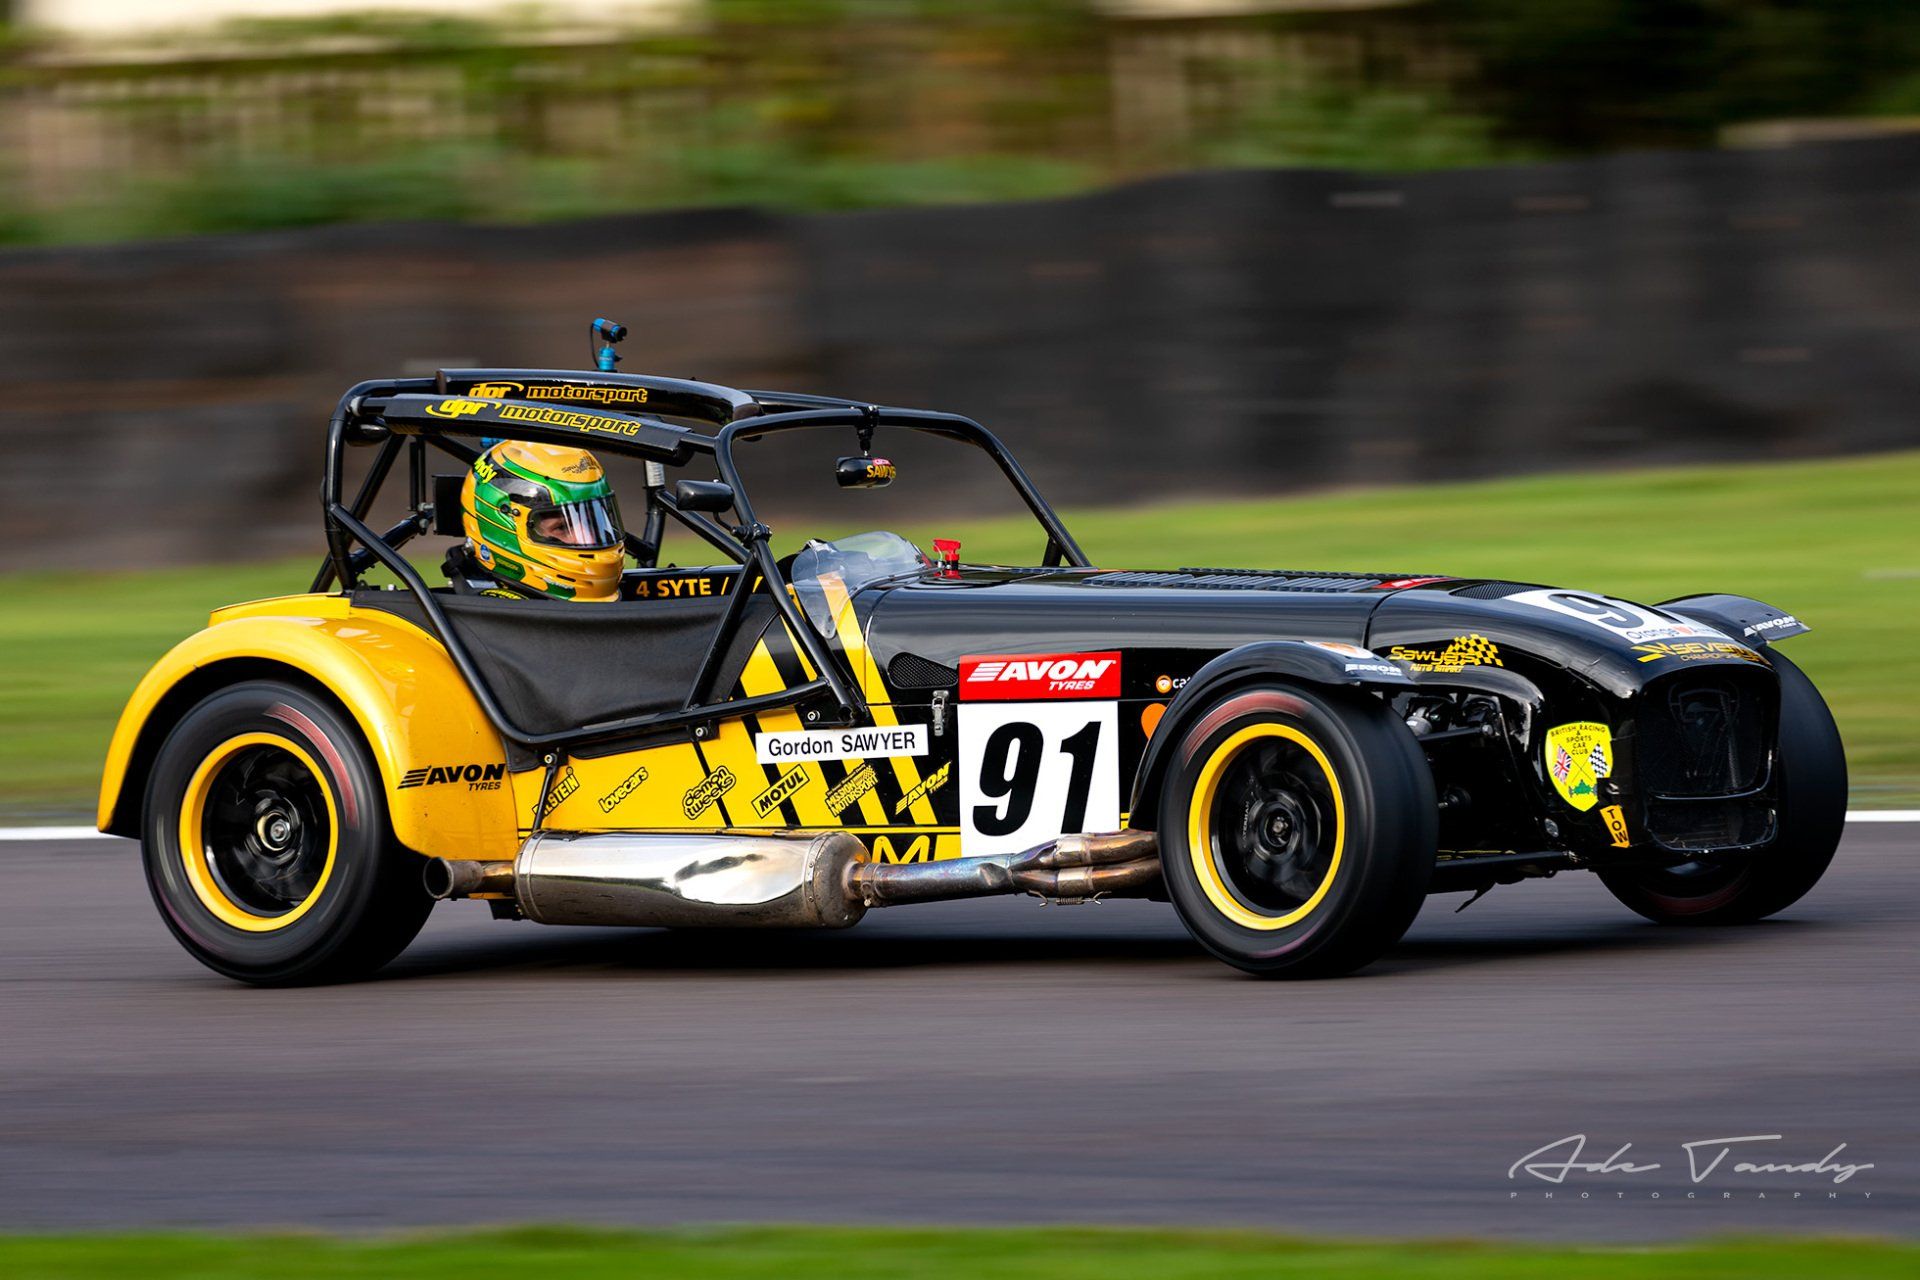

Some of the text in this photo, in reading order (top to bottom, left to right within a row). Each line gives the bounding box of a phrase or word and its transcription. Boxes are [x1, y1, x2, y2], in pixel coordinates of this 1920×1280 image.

[526, 384, 648, 403] motorsport
[424, 399, 642, 437] dpr motorsport
[636, 581, 649, 597] 4
[657, 578, 712, 597] SYTE
[998, 659, 1113, 682] AVON
[1048, 680, 1095, 691] TYRES
[1550, 724, 1606, 737] BRITISH RACING
[1566, 735, 1592, 743] SPORTS
[768, 731, 916, 757] Gordon SAWYER
[426, 763, 506, 785] AVON
[468, 781, 501, 792] TYRES
[906, 763, 951, 807] AVON
[972, 720, 1102, 837] 91
[598, 766, 649, 813] lovecars
[685, 768, 728, 807] demon
[687, 775, 734, 817] tweeks
[758, 771, 804, 813] MOTUL
[1607, 808, 1628, 843] TOW
